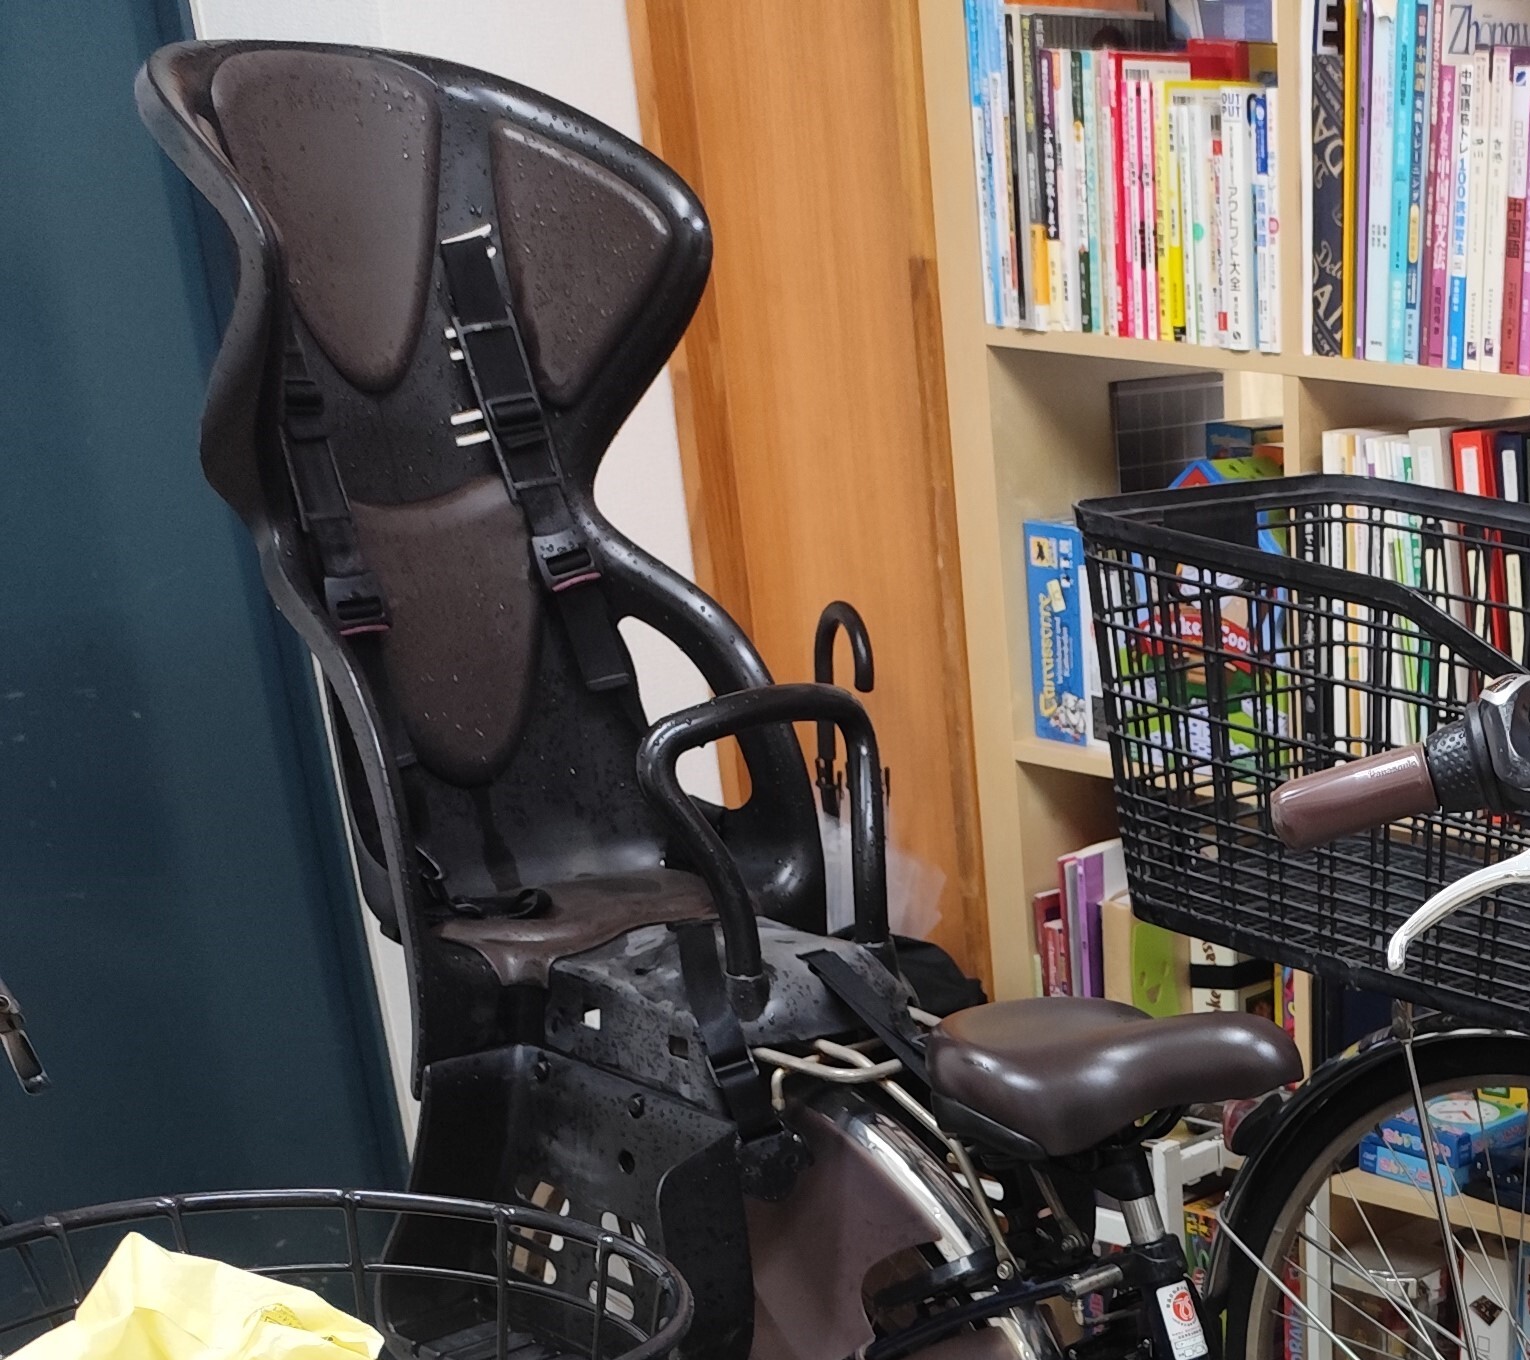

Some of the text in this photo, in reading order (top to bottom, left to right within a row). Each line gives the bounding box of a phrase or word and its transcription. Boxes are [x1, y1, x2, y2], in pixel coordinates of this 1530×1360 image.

[1221, 93, 1241, 117] OUT PUT
[1506, 199, 1524, 258] 中国語
